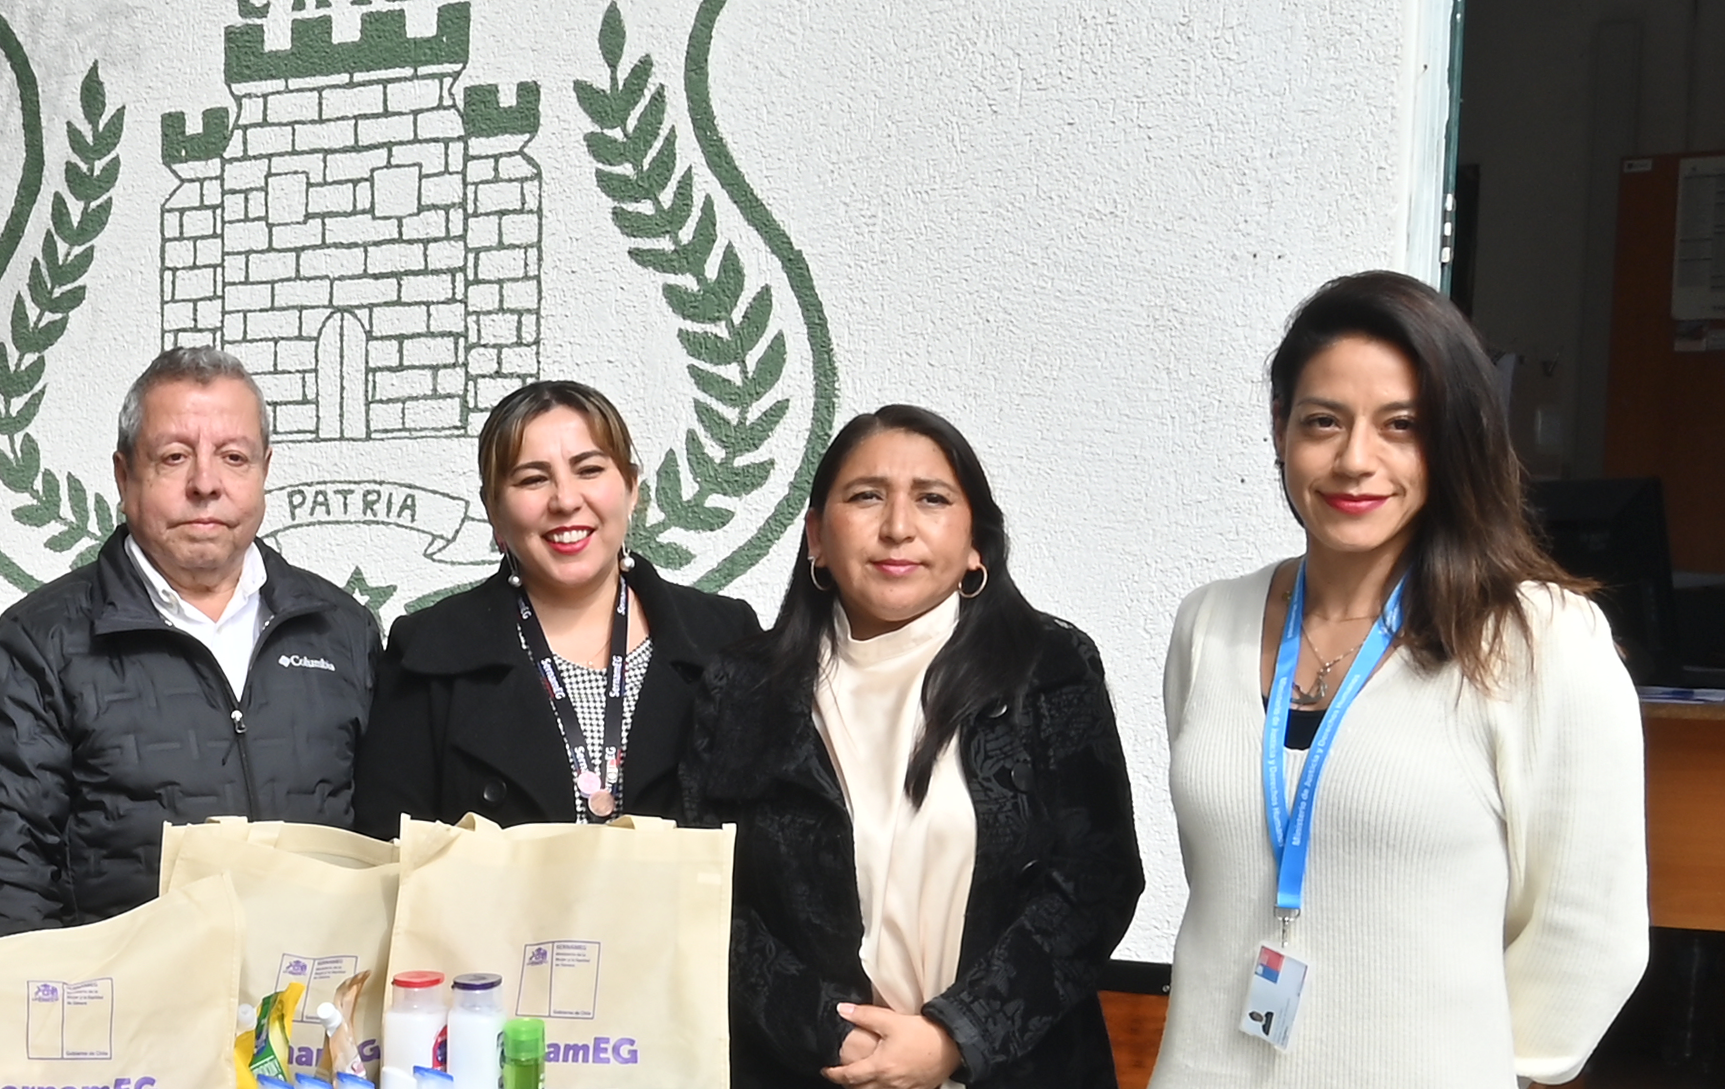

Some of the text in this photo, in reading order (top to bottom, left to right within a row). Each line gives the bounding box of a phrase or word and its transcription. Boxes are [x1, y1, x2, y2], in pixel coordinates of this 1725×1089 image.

[287, 489, 417, 524] PATRIA
[289, 653, 336, 672] Columbia
[1291, 804, 1307, 847] Ministerio
[545, 1036, 639, 1065] amEG
